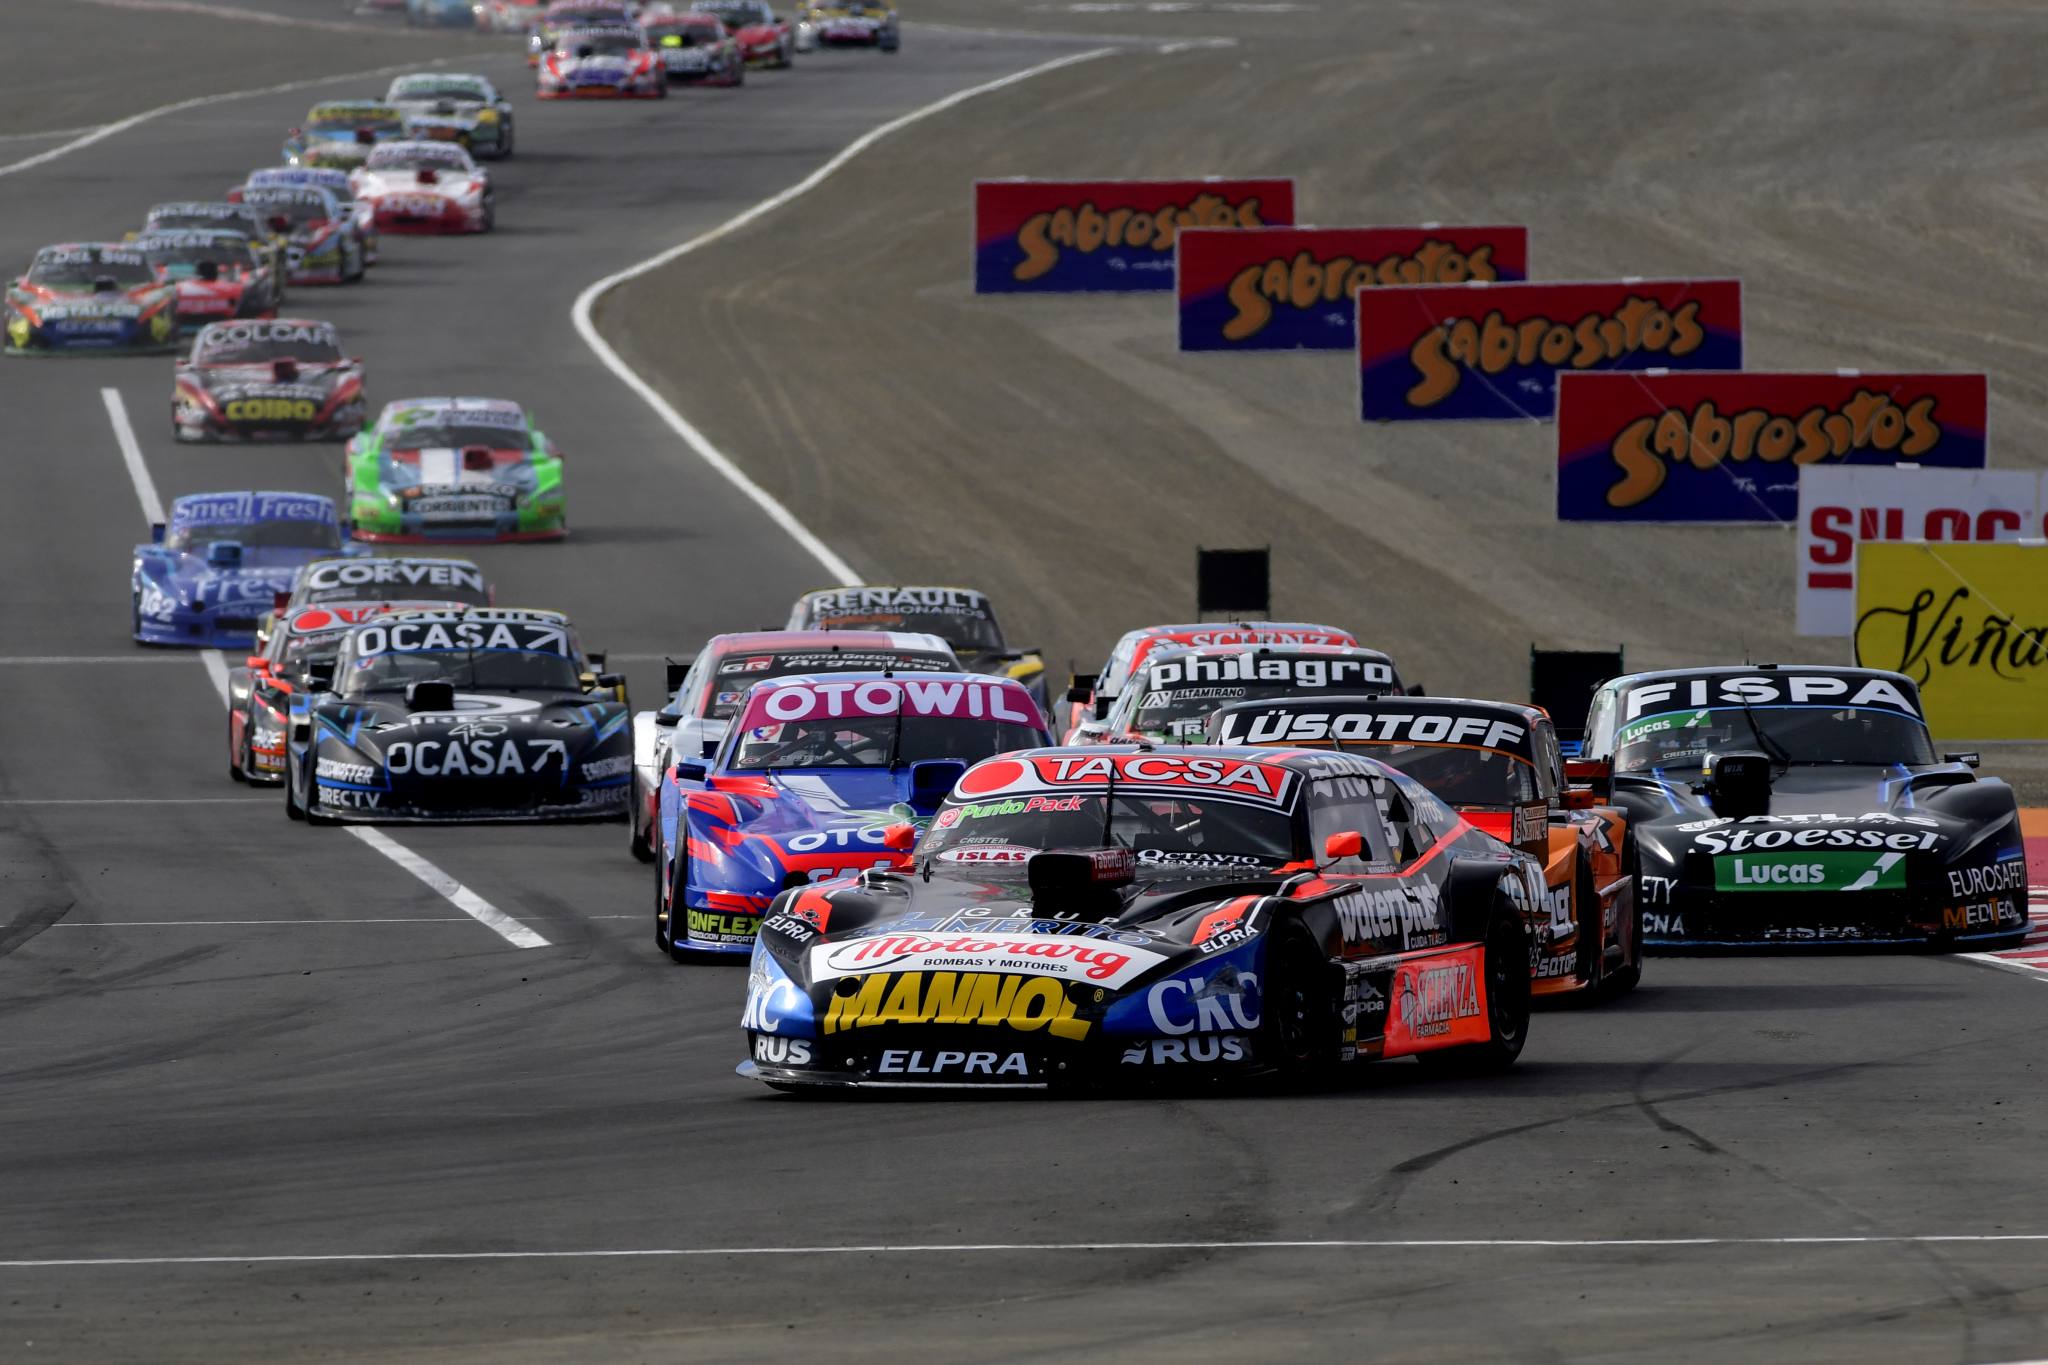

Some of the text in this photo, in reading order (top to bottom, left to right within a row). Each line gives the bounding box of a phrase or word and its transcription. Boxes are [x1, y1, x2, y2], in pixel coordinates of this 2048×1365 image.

[176, 494, 250, 520] Smell
[259, 498, 334, 523] Fresh
[309, 565, 485, 593] CORVEN
[812, 589, 981, 613] RENAULT
[356, 623, 519, 657] OCASA
[1151, 652, 1393, 691] philagro
[764, 681, 1030, 723] OTOWIL
[1174, 688, 1245, 700] ALTAMIRANO
[1626, 675, 1922, 721] FISPA
[1216, 709, 1525, 748] LÜSQTOFF
[1627, 719, 1671, 741] Lucas
[387, 739, 525, 776] OCASA
[1722, 764, 1745, 773] WIX
[1050, 757, 1274, 795] TACSA
[958, 795, 1087, 821] Punto Pack
[1738, 812, 1941, 828] ATLAS
[960, 837, 1009, 845] CRISTEM
[1694, 829, 1940, 855] Stoessel
[956, 852, 1026, 862] ISLAS
[1734, 858, 1826, 885] Lucas
[763, 914, 814, 943] ELPRA
[1199, 924, 1260, 954] ELPRA
[854, 936, 1132, 980] Motorarg
[924, 957, 1069, 973] BOMBAS Y MOTORES
[824, 971, 1092, 1041] MANNOL
[1416, 961, 1481, 1024] SCIENZA
[1416, 1023, 1451, 1039] FARMACIA
[756, 1035, 812, 1065] RUS
[878, 1049, 1029, 1076] ELPRA
[1151, 1035, 1244, 1065] RUS
